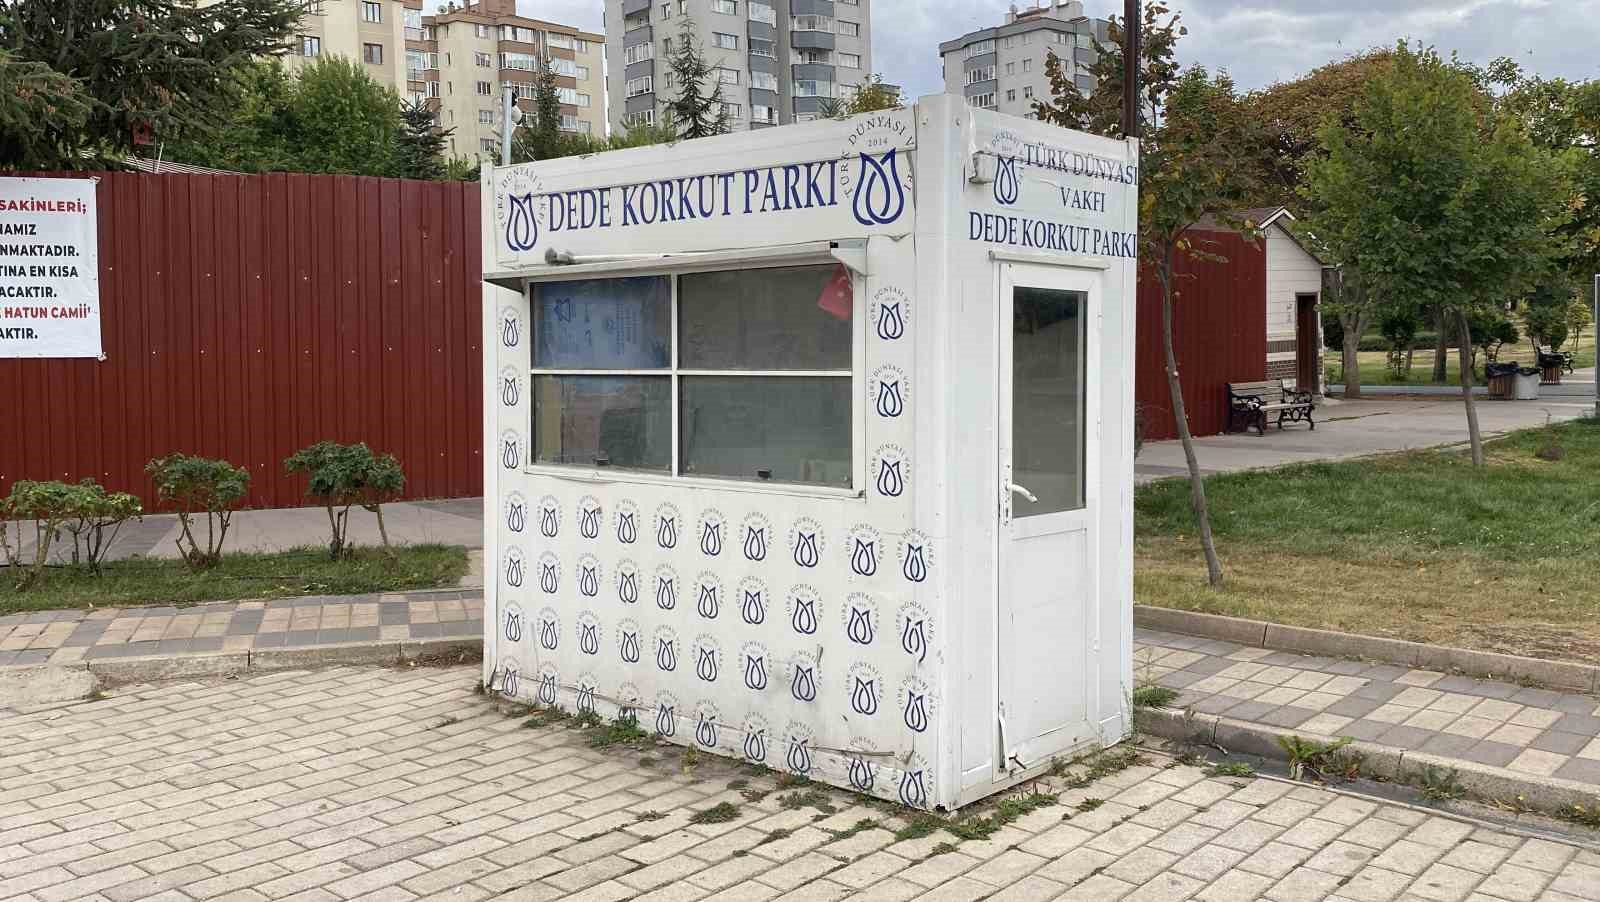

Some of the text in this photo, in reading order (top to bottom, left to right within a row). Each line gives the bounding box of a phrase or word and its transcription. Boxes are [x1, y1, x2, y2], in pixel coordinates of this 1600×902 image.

[1023, 141, 1069, 173] TÜRK
[549, 159, 838, 232] DEDE KORKUT PARKI
[1060, 186, 1105, 213] VAKFI
[969, 211, 1137, 258] DEDE KORKUT PARKI
[29, 265, 46, 277] EN
[50, 265, 79, 278] KISA
[4, 306, 48, 319] HATUN
